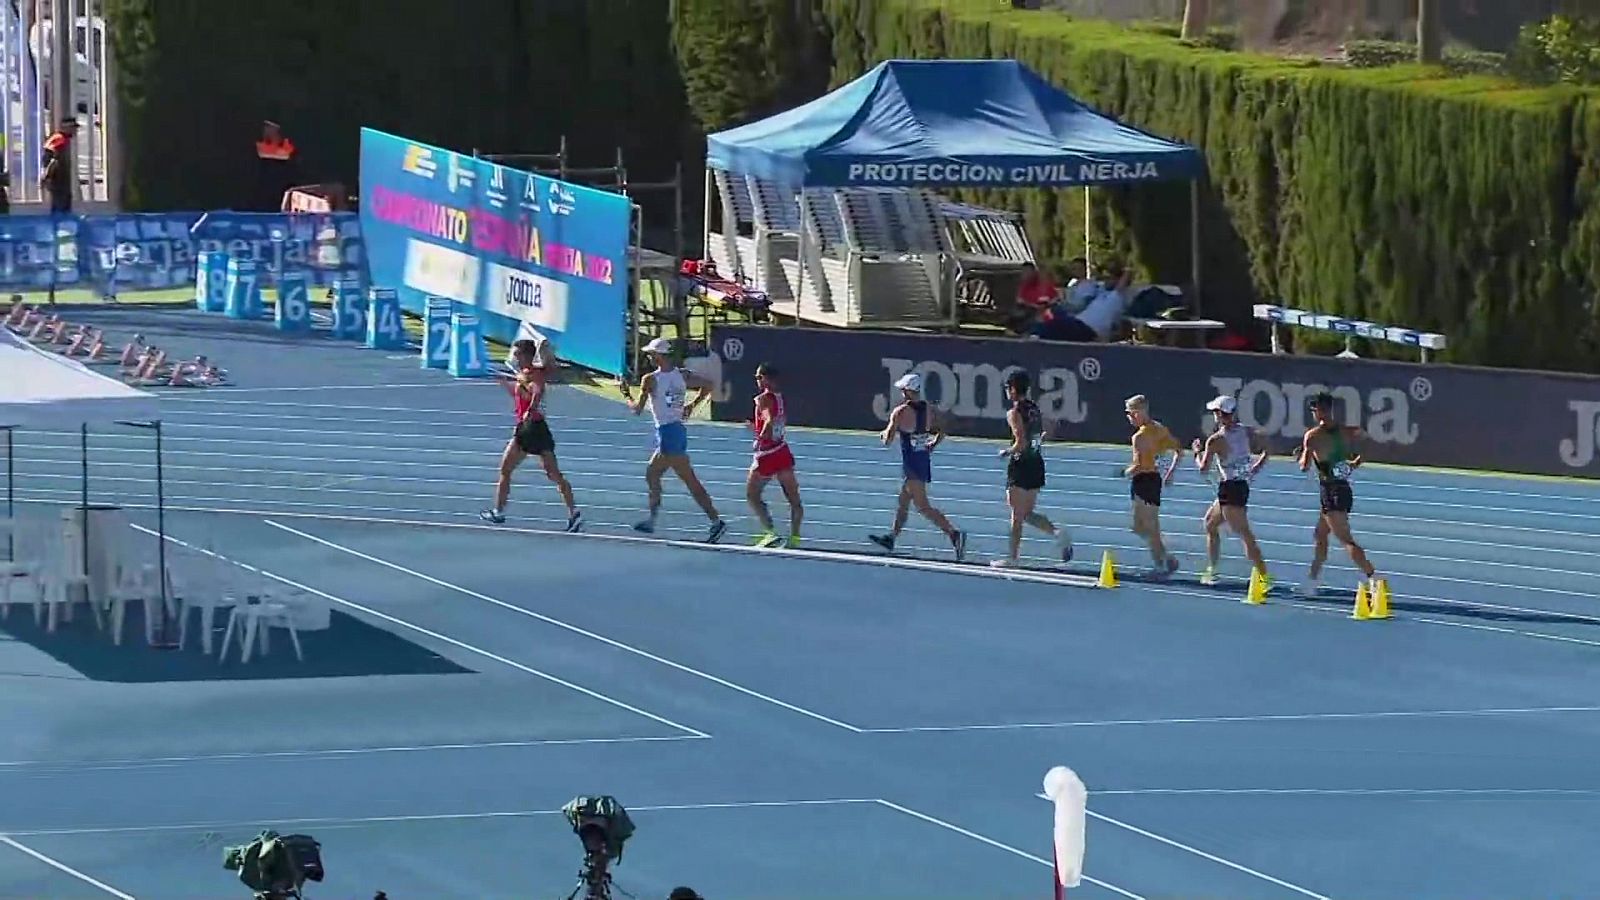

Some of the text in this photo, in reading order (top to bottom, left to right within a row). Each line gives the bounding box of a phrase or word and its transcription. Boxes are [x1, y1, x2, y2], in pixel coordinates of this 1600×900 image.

[849, 161, 1160, 183] PROTECCION CIVIL NERJA
[210, 269, 225, 303] 8
[239, 274, 257, 311] 7
[283, 286, 307, 321] 6
[344, 294, 363, 332] 5
[377, 303, 400, 341] 4
[430, 322, 452, 361] 2
[461, 331, 481, 370] 1
